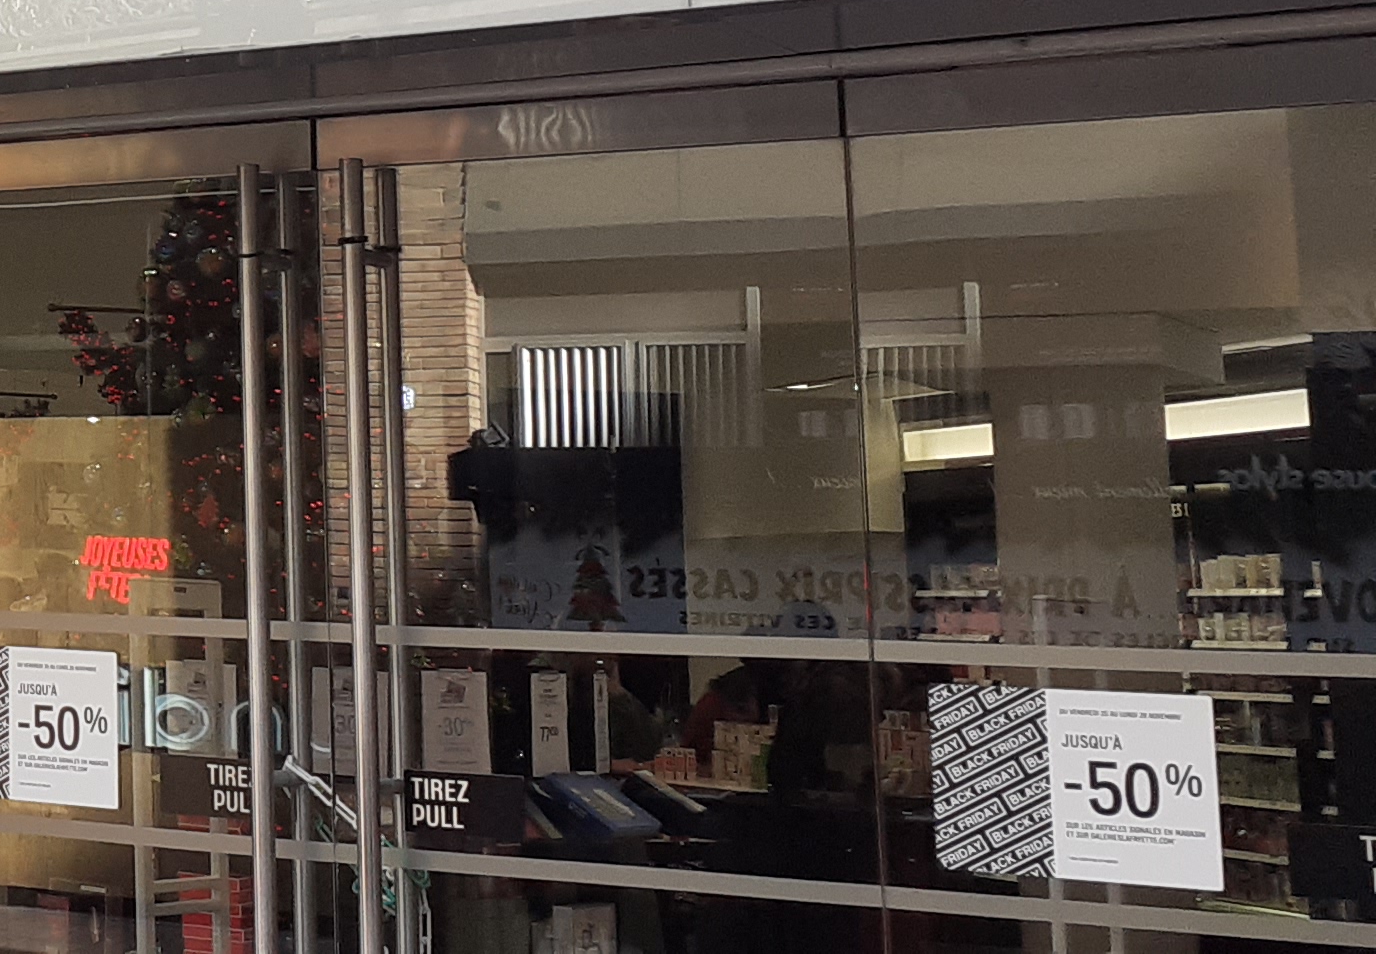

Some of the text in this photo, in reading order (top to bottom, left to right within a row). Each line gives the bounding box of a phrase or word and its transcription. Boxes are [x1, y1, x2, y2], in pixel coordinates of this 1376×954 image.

[80, 535, 171, 571] JOYEUSES
[87, 567, 132, 604] FÊTE
[17, 682, 58, 697] JUSQU'À
[17, 704, 108, 751] -50%
[934, 702, 977, 730] FRIDAY
[968, 714, 1010, 740] BLACK
[951, 729, 1035, 777] BLACK FRIDAY
[1061, 733, 1123, 751] JUSQU'À
[207, 763, 251, 787] TIRE
[213, 790, 251, 814] PUL
[410, 777, 470, 804] TIREZ
[934, 766, 1018, 814] BLACK FRIDAY
[1009, 778, 1051, 805] BLACK
[1063, 760, 1203, 819] -50%
[412, 803, 465, 830] PULL
[957, 803, 1001, 831] FRIDAY
[991, 815, 1034, 843] BLACK
[940, 840, 985, 868] FRIDAY
